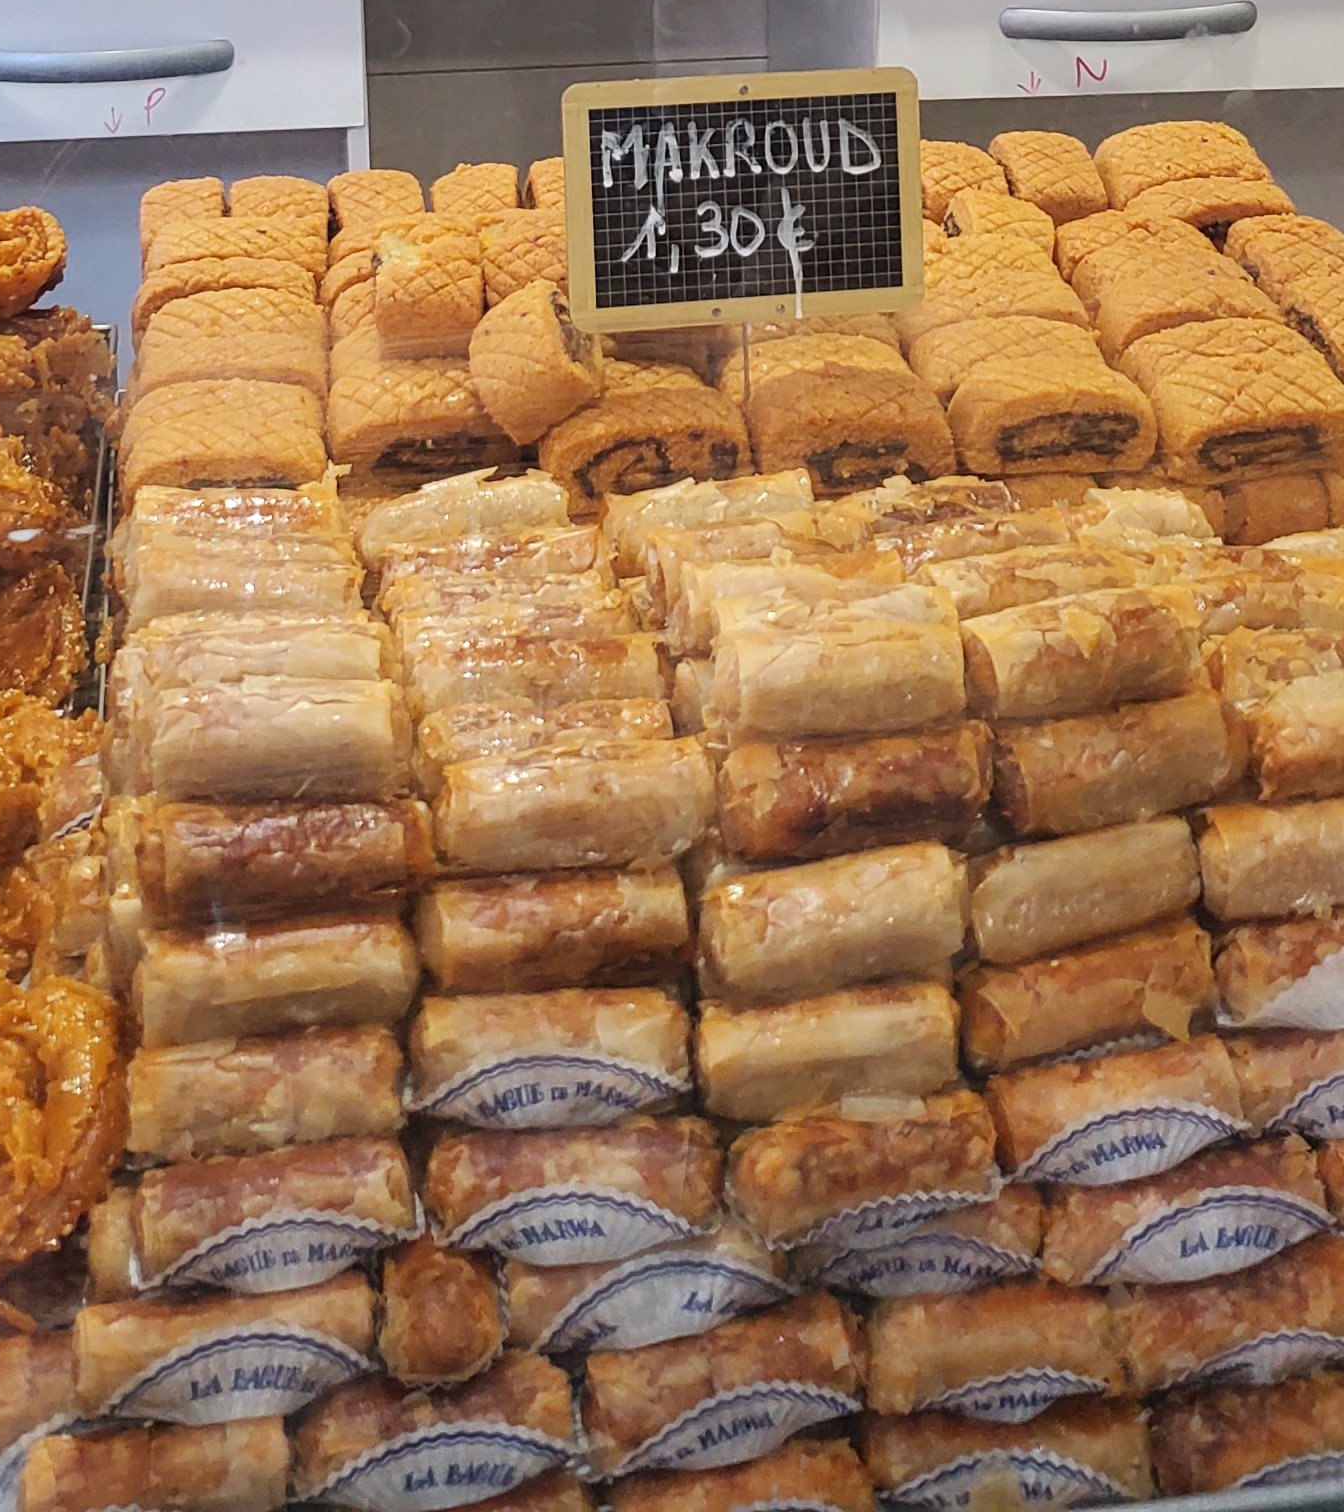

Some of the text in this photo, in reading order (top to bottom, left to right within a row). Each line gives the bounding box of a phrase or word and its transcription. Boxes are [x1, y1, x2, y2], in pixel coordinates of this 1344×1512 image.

[1076, 56, 1107, 88] N
[601, 116, 882, 190] MAKROUD
[1091, 1132, 1168, 1166] MARWA
[520, 1218, 606, 1246] MARWA
[1180, 1224, 1282, 1259] LA BAGUE
[681, 1290, 713, 1313] LA
[189, 1364, 303, 1400] LA BAGUE
[403, 1465, 438, 1492] LA
